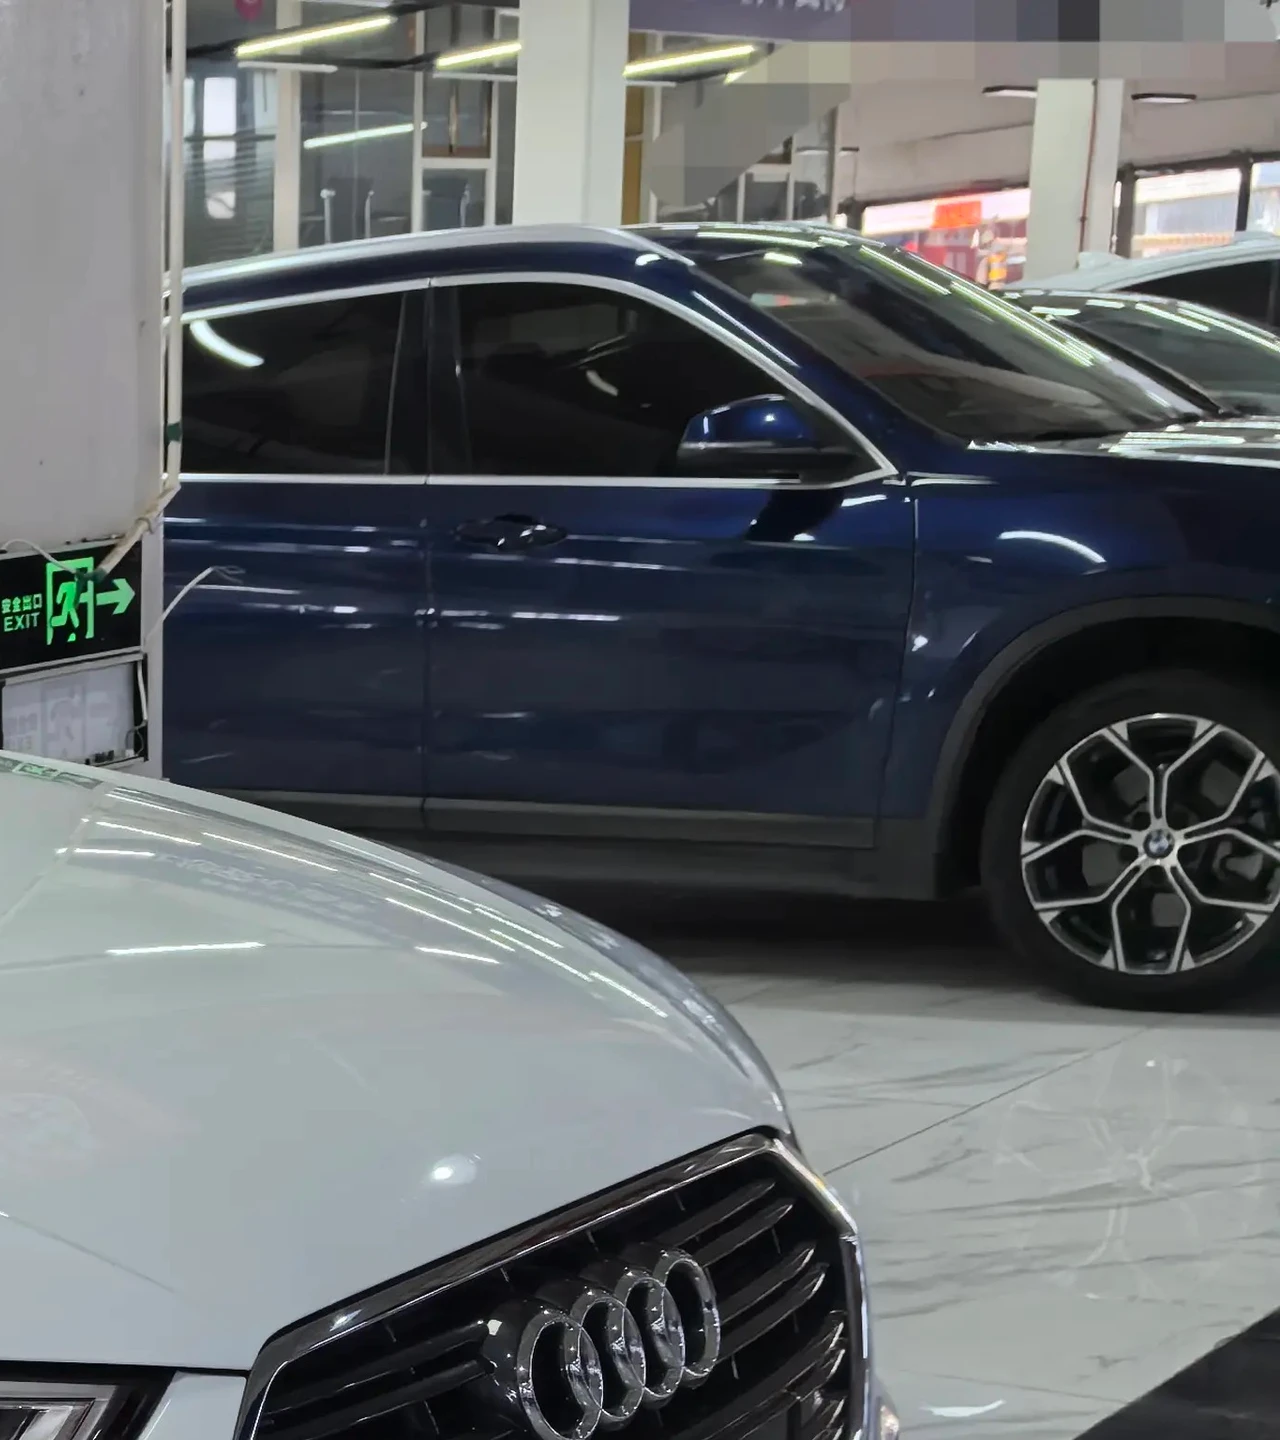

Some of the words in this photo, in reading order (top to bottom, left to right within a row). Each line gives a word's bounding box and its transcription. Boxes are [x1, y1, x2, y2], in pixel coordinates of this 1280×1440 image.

[1, 593, 43, 614] 安全出口
[4, 612, 40, 632] EXIT
